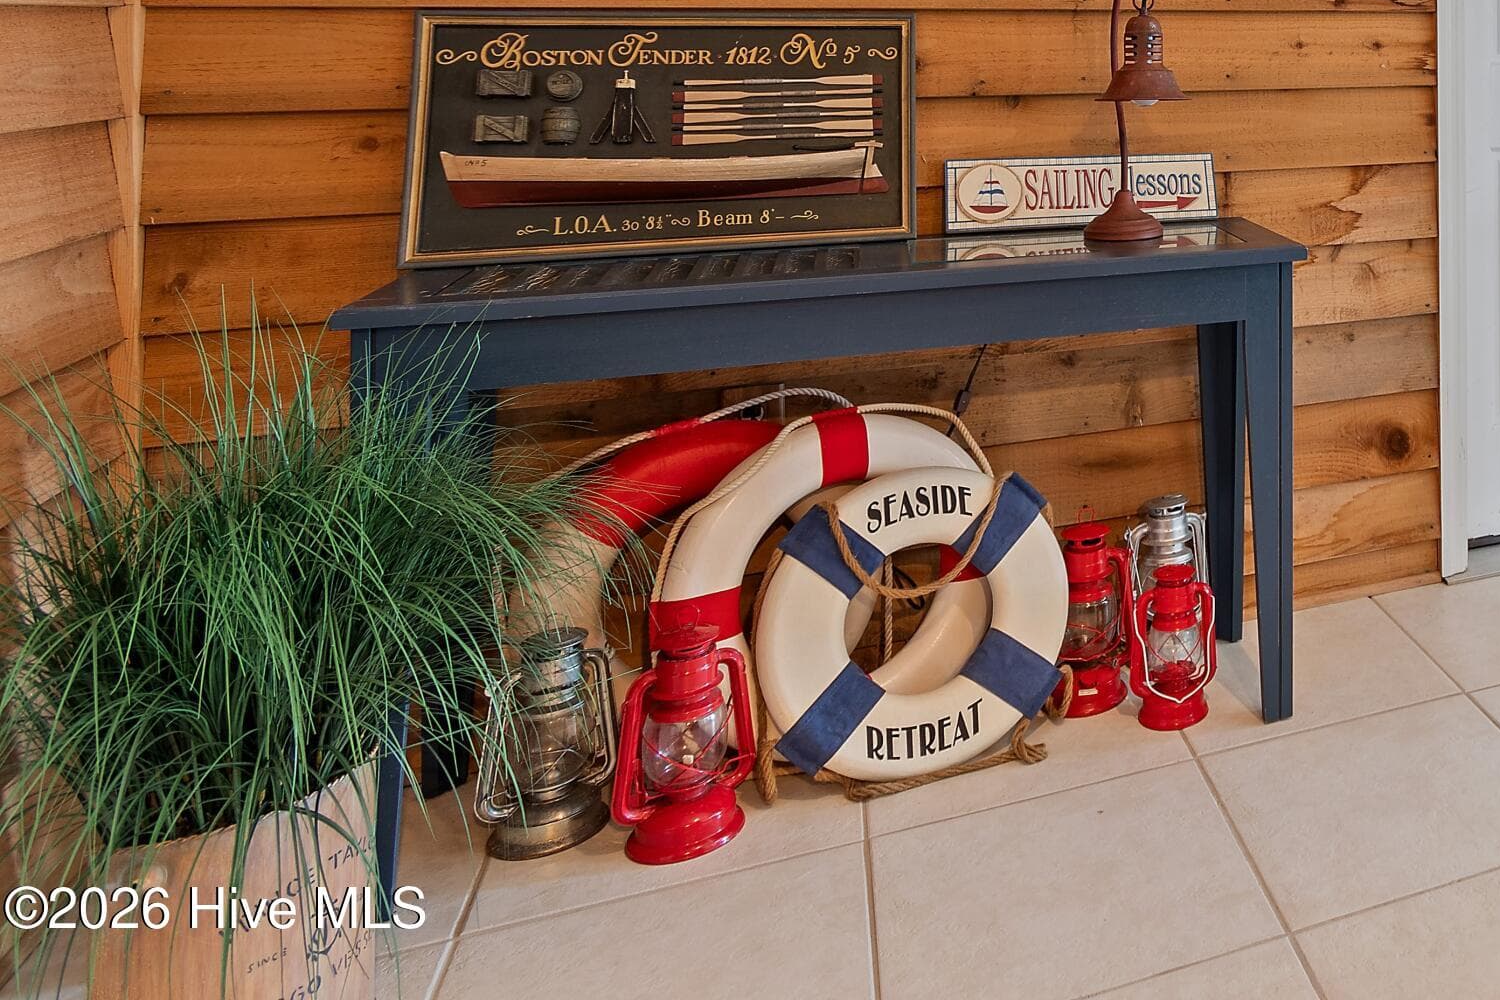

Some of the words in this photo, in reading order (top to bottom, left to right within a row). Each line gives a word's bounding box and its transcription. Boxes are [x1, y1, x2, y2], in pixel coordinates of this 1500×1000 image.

[480, 32, 604, 72] BOSTON
[608, 31, 715, 67] TENDER
[724, 46, 772, 65] 1812
[843, 45, 861, 65] 5
[1024, 168, 1115, 211] SAILING
[1128, 165, 1202, 196] lessons
[552, 214, 617, 236] L.O.A.
[697, 209, 753, 228] Beam
[866, 484, 973, 534] SEASIDE
[865, 697, 983, 761] RETREAT
